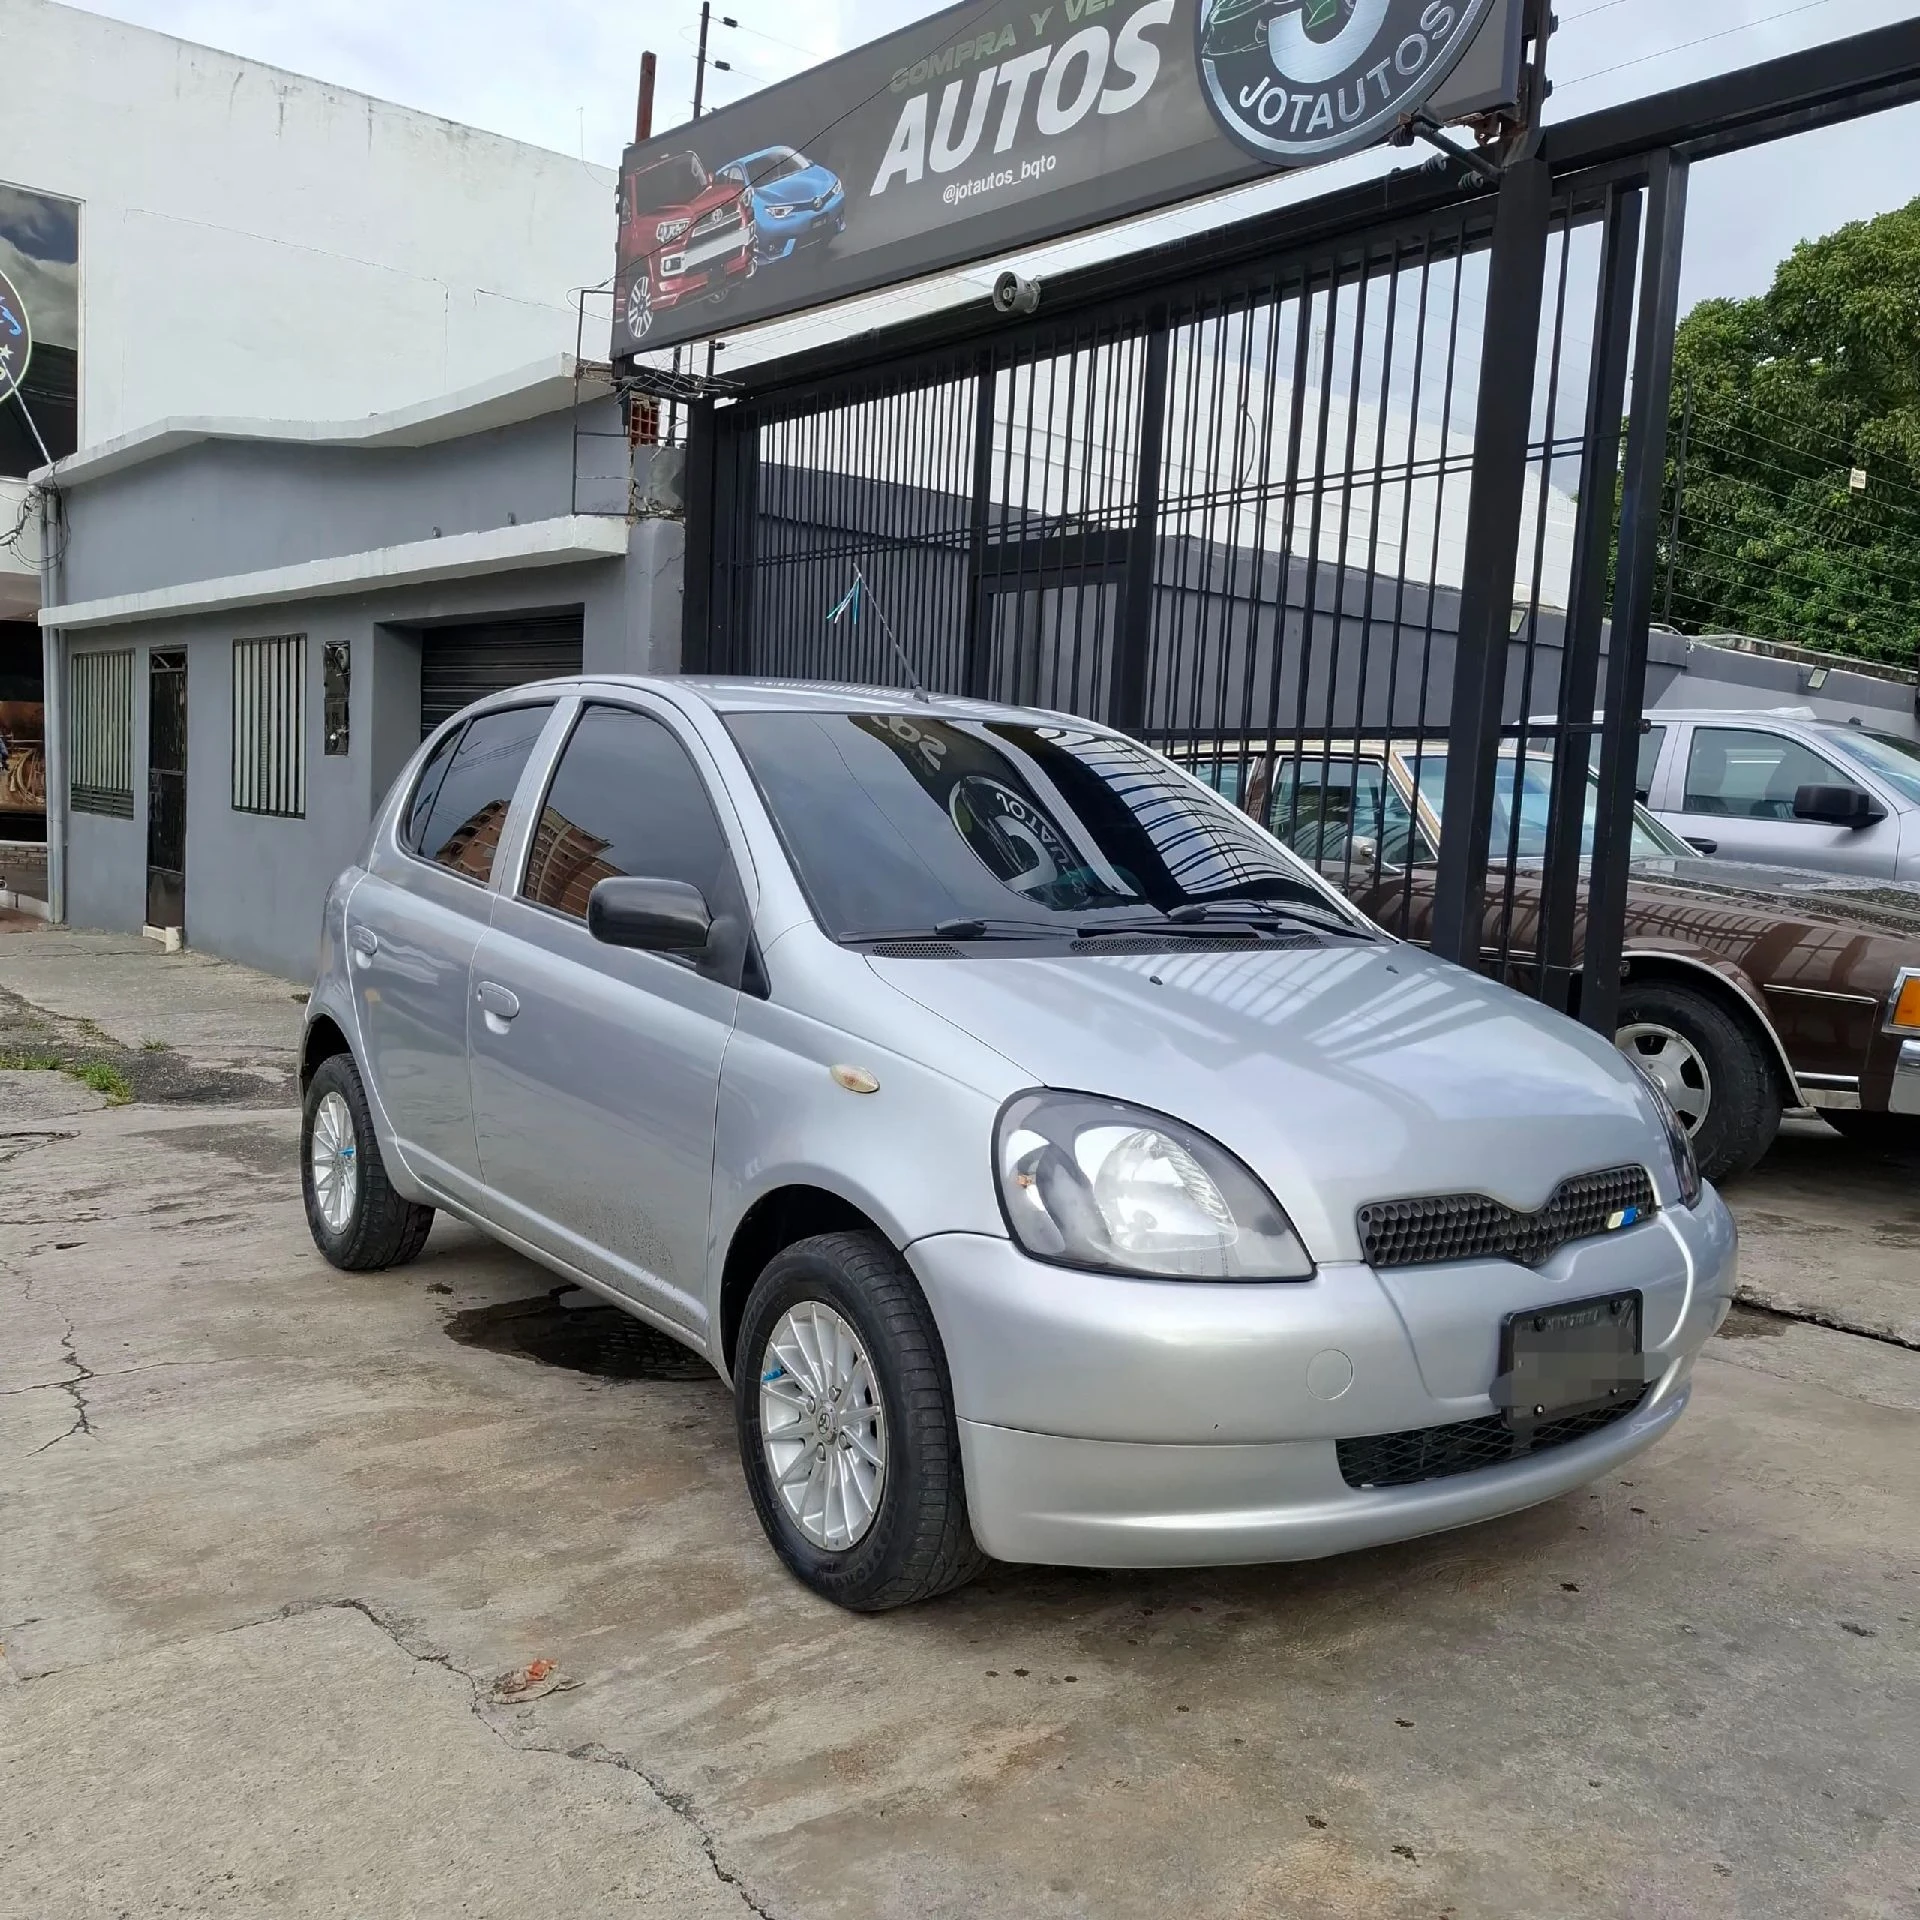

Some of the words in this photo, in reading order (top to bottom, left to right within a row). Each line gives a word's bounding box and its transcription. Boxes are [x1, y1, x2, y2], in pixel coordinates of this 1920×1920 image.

[869, 0, 1176, 197] AUTOS
[889, 23, 1017, 93] COMPRA
[1028, 7, 1055, 36] Y
[1239, 0, 1456, 134] JOTAUTOS
[942, 153, 1058, 206] @jotautos_bqto
